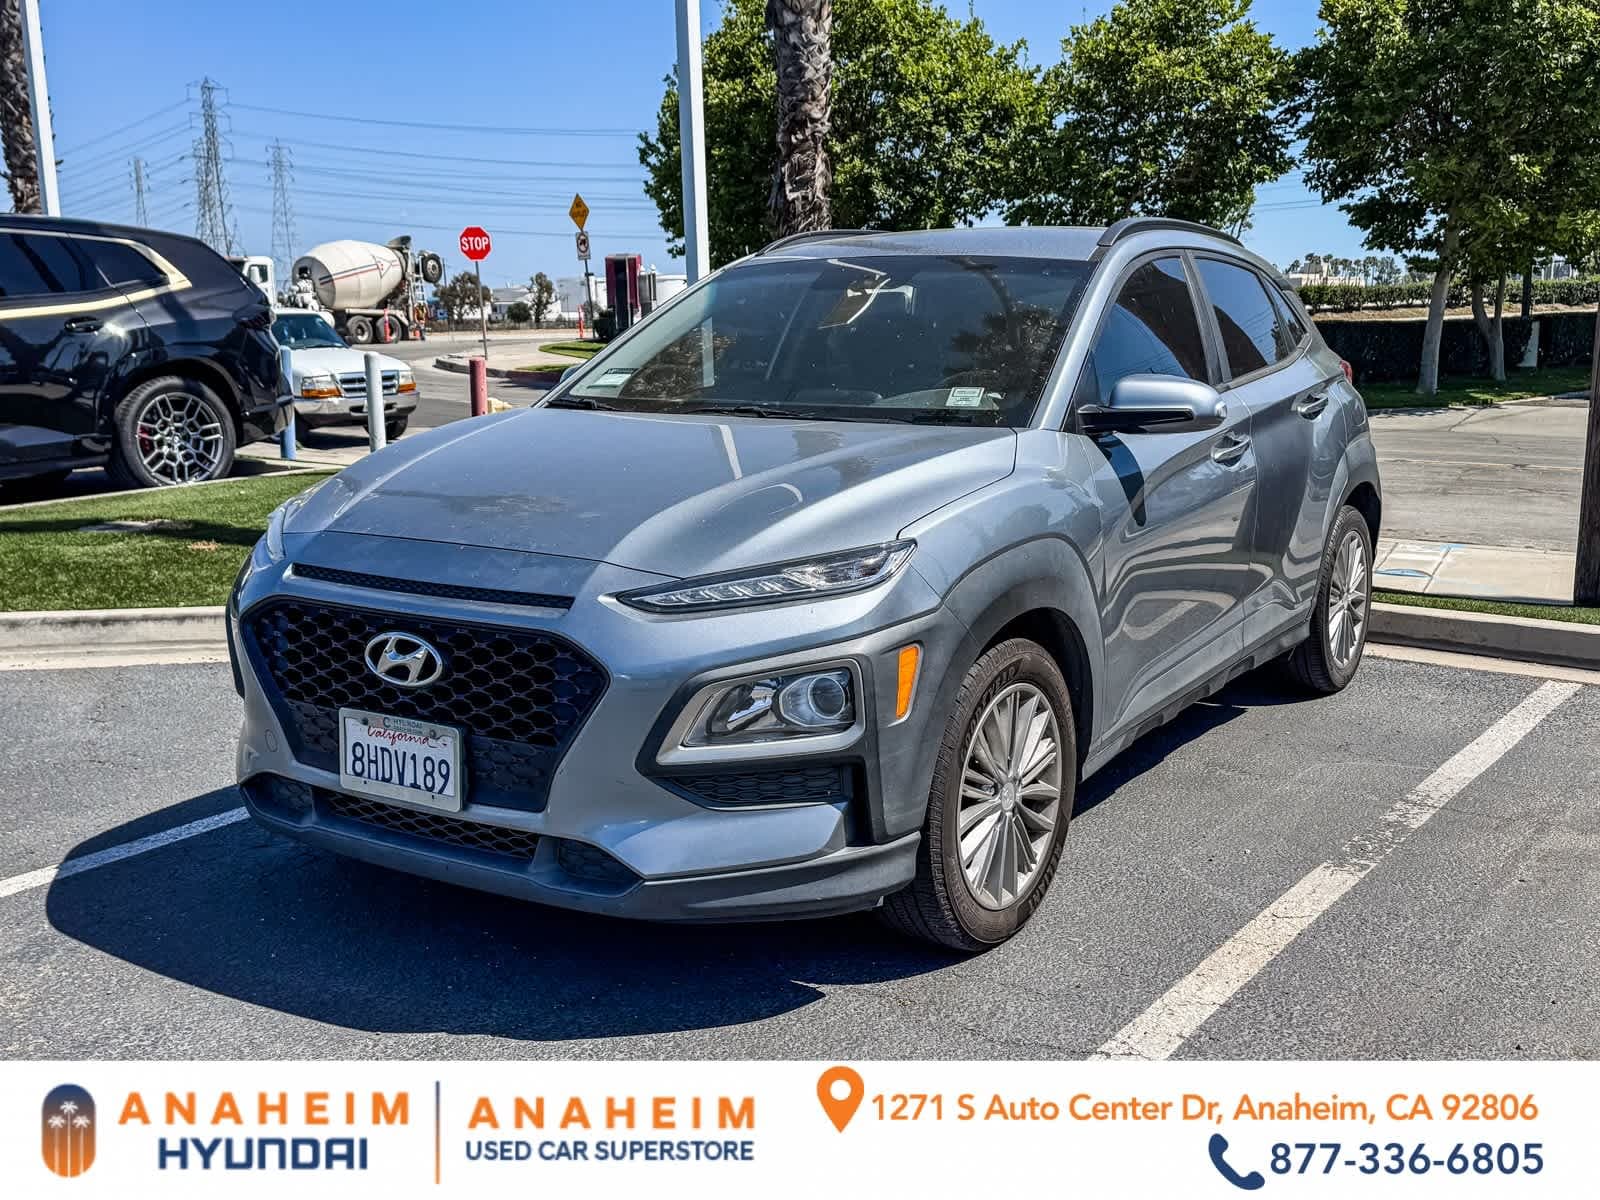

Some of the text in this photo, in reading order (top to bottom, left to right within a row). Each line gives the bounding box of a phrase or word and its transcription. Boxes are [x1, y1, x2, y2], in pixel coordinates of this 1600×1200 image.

[461, 236, 489, 251] STOP
[367, 725, 431, 746] California
[352, 741, 450, 795] 8HDV189
